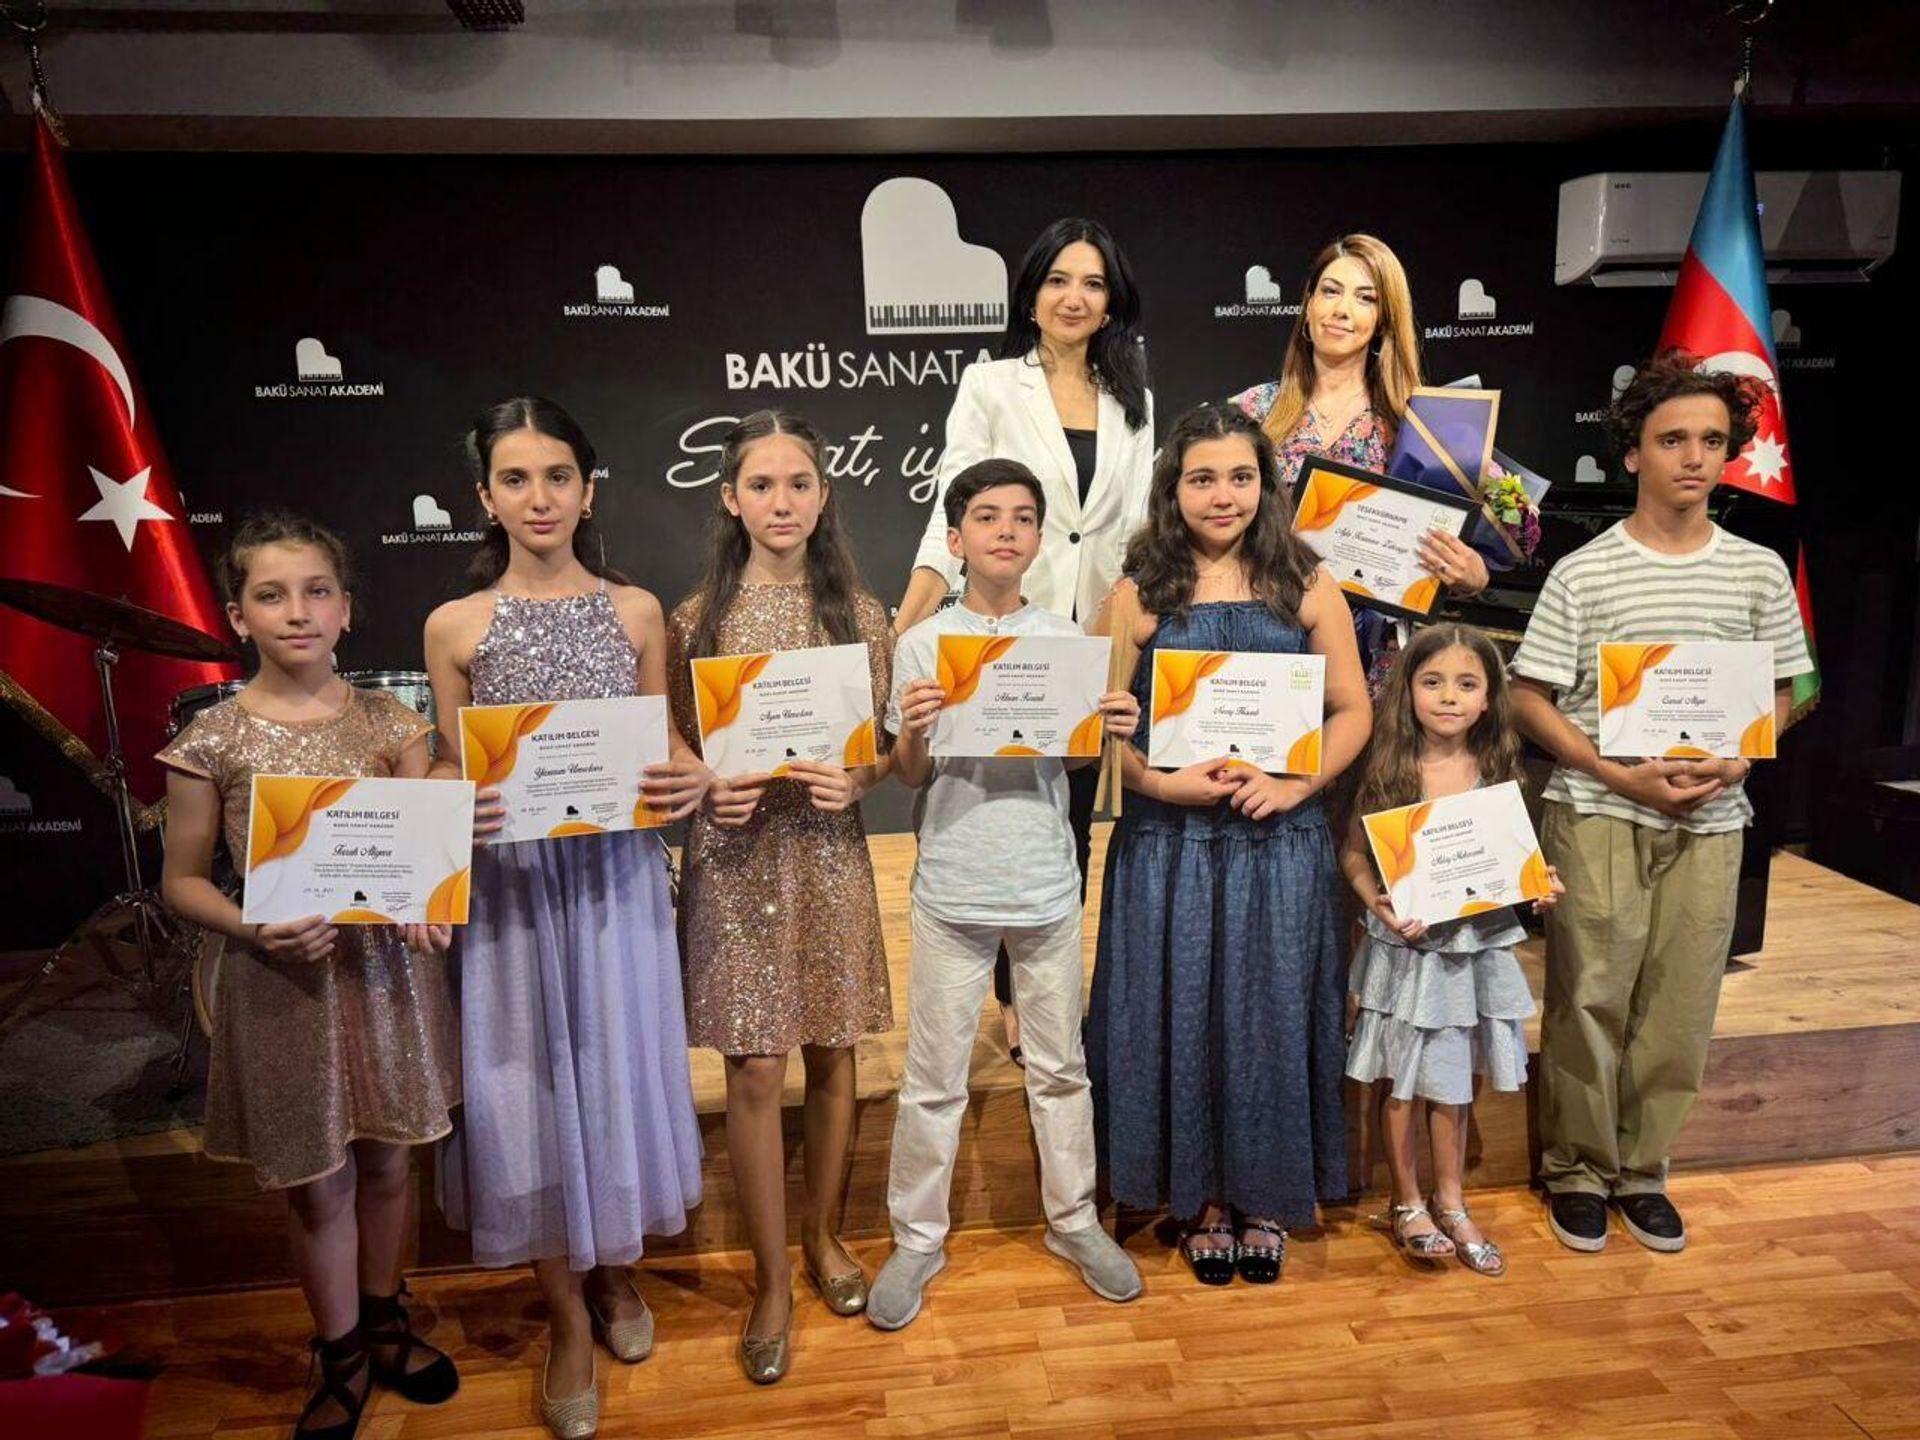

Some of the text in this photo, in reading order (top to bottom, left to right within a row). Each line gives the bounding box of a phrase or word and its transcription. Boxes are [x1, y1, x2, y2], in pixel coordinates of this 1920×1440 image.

[563, 304, 670, 316] BAKÜ SANAT AKADEMİ
[1214, 305, 1301, 317] BAKÜ SANAT AKADE
[1425, 323, 1534, 339] BAKÜ SANAT AKADEMİ
[725, 344, 831, 390] BAKÜ
[838, 350, 963, 388] SANAT
[255, 382, 384, 397] BAKÜ SANAT AKADEMİ
[190, 512, 223, 524] ADEMİ
[382, 531, 486, 544] BAKÜ SANAT AKADEM
[531, 731, 565, 743] KATILIM
[326, 809, 400, 821] KATILIM BELGESİ
